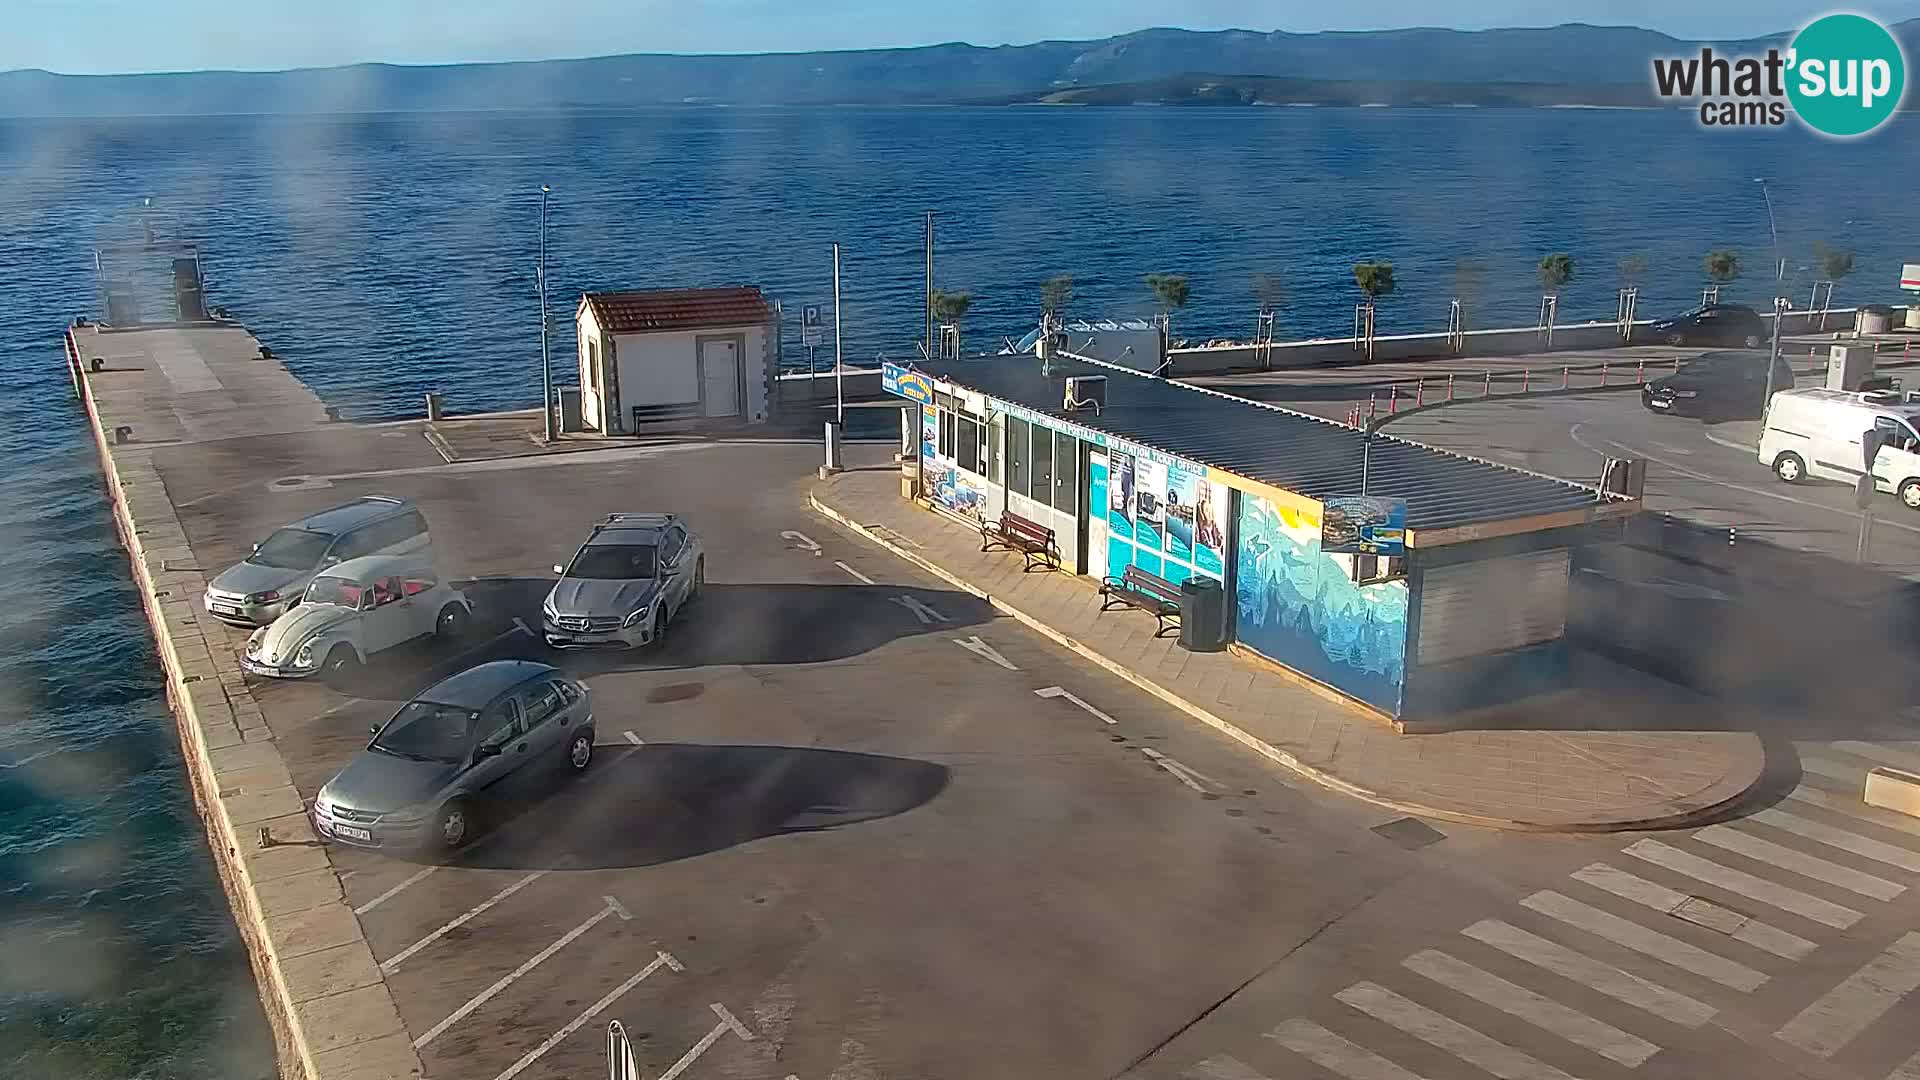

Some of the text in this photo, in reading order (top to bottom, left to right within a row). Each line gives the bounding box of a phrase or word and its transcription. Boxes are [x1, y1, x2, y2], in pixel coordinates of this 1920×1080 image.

[807, 308, 817, 324] P
[1120, 440, 1150, 459] STATION
[1152, 452, 1177, 467] TICKET
[1178, 459, 1203, 476] OFFICE
